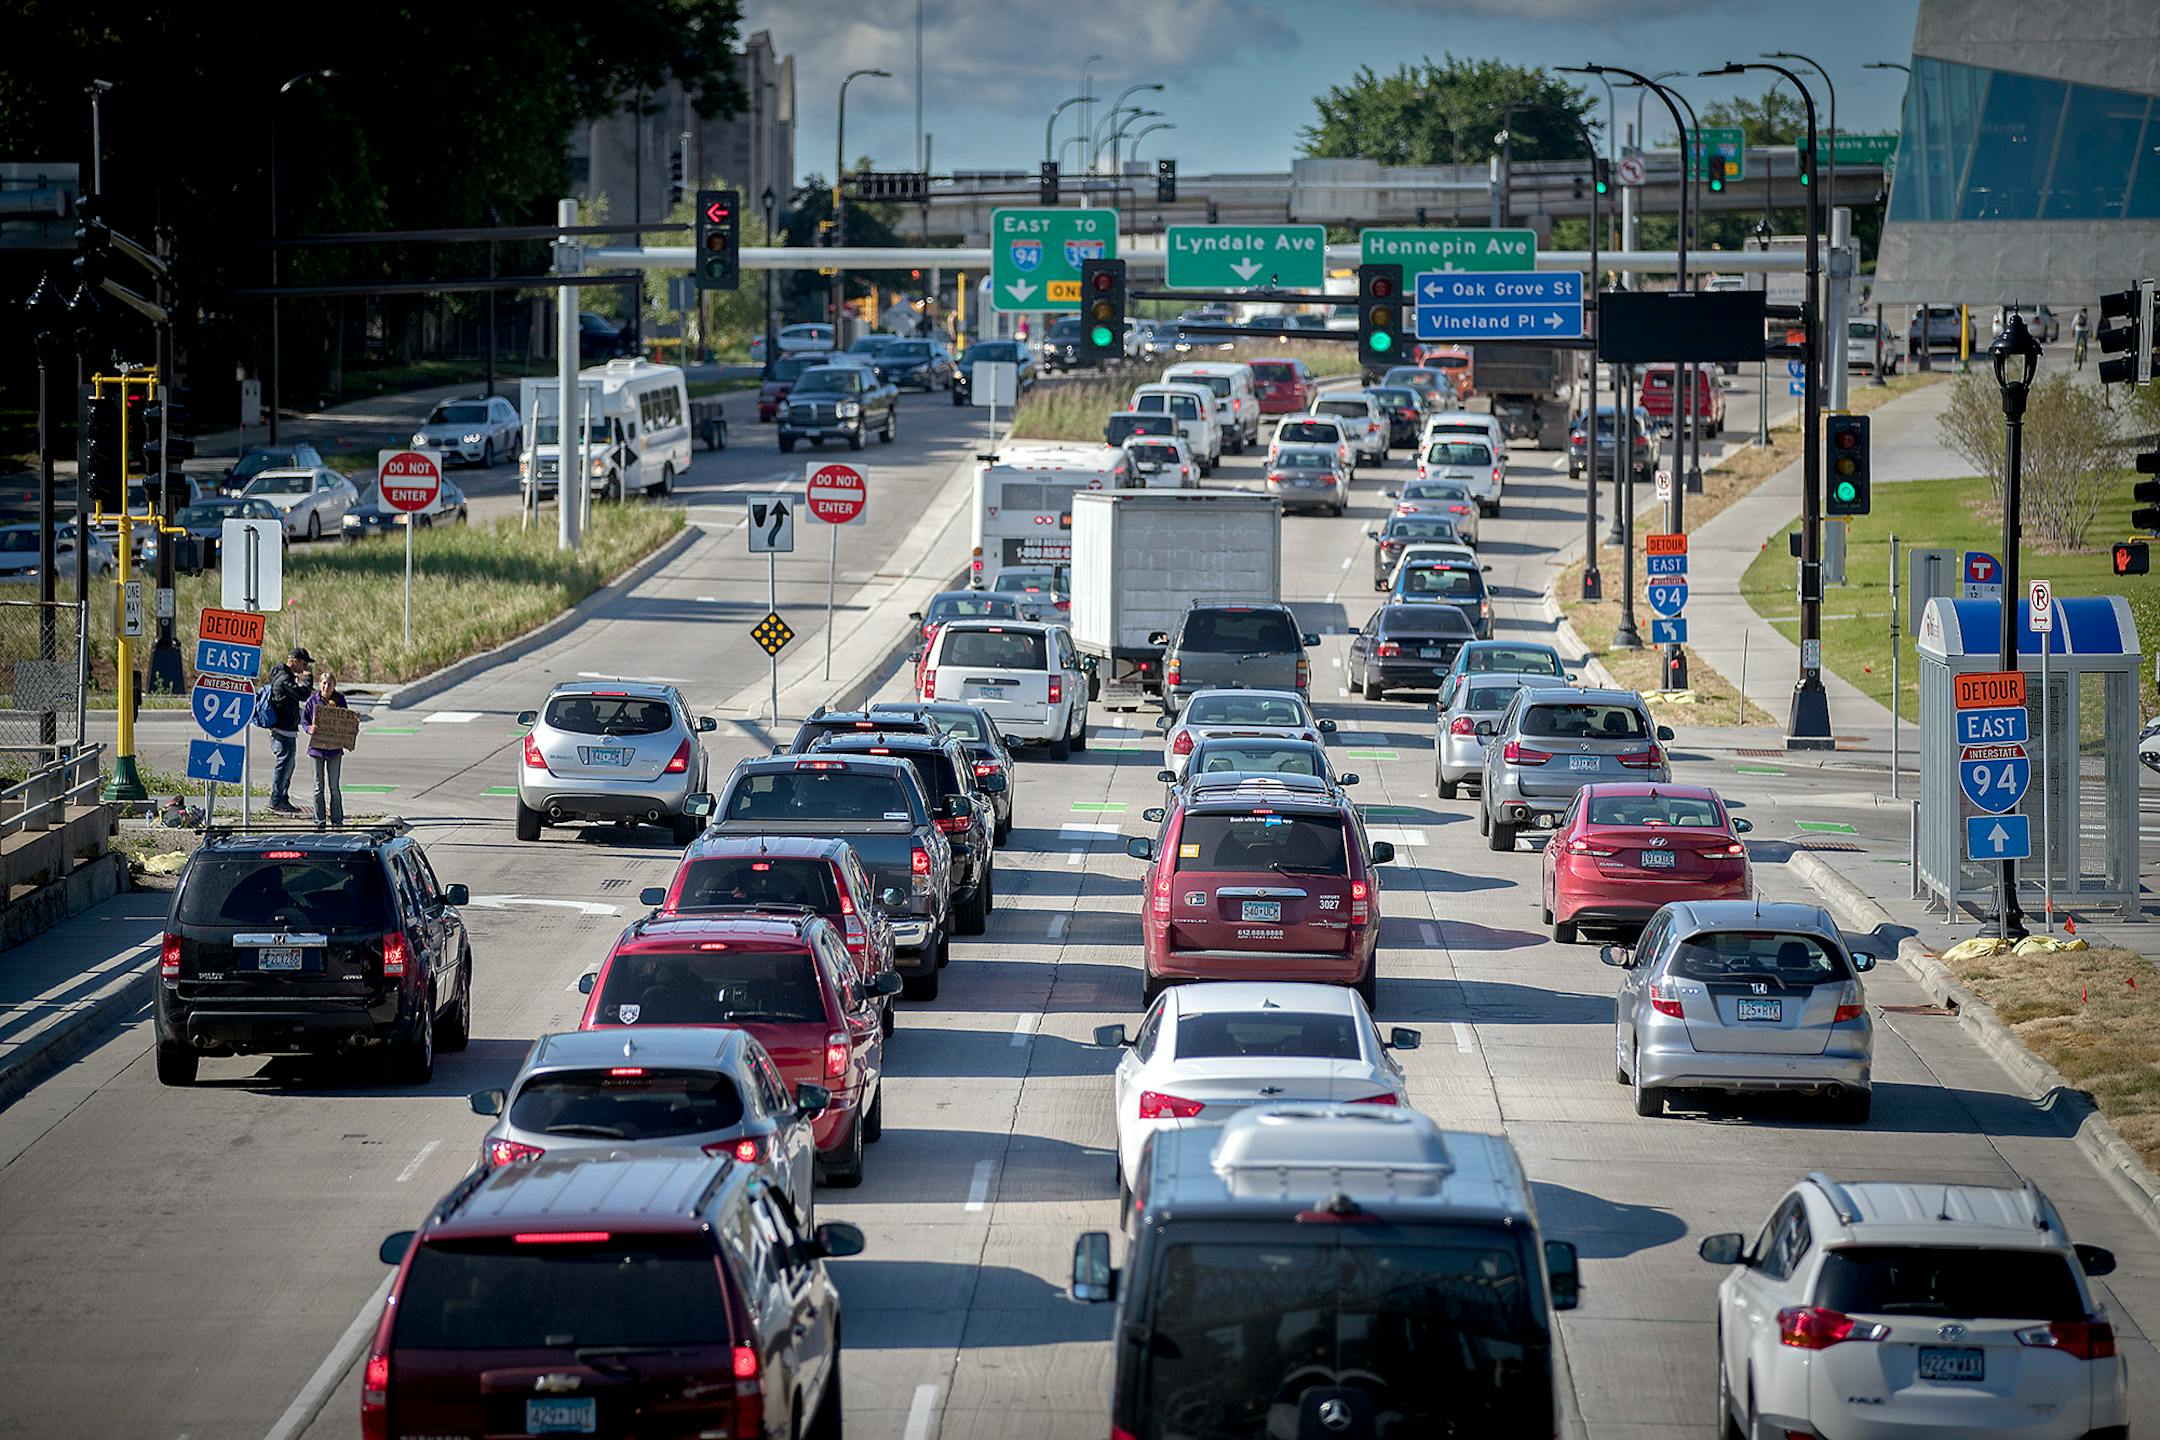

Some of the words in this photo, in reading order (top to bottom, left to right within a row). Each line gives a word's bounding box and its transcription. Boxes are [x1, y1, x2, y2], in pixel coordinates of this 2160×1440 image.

[1004, 217, 1051, 233] EAST
[1075, 219, 1097, 233] TO
[1175, 234, 1265, 254] Lyndale
[1275, 234, 1316, 251] Ave
[1369, 236, 1477, 258] Hennepin
[1486, 238, 1527, 255] Ave
[1015, 248, 1038, 265] 94
[1053, 285, 1081, 298] ON
[1452, 282, 1486, 297] Oak
[1494, 282, 1545, 297] Grove
[1553, 281, 1573, 296] St
[1431, 314, 1510, 329] Vineland
[1518, 314, 1535, 328] Pl
[389, 462, 405, 474] DO
[409, 462, 431, 475] NOT
[816, 474, 832, 486] DO
[836, 475, 858, 487] NOT
[392, 490, 428, 502] ENTER
[818, 502, 853, 514] ENTER
[1650, 539, 1684, 551] DETOUR
[1652, 558, 1681, 571] EAST
[127, 585, 139, 599] ONE
[1655, 587, 1681, 607] 94
[127, 601, 140, 614] WAY
[206, 615, 259, 640] DETOUR
[206, 647, 252, 671] EAST
[203, 678, 248, 692] INTERSTATE
[1962, 680, 2018, 702] DETOUR
[203, 693, 241, 726] 94
[1967, 716, 2015, 739] EAST
[1969, 748, 2018, 759] INTERSTATE
[1972, 763, 2017, 797] 94
[1319, 900, 1340, 910] 3027
